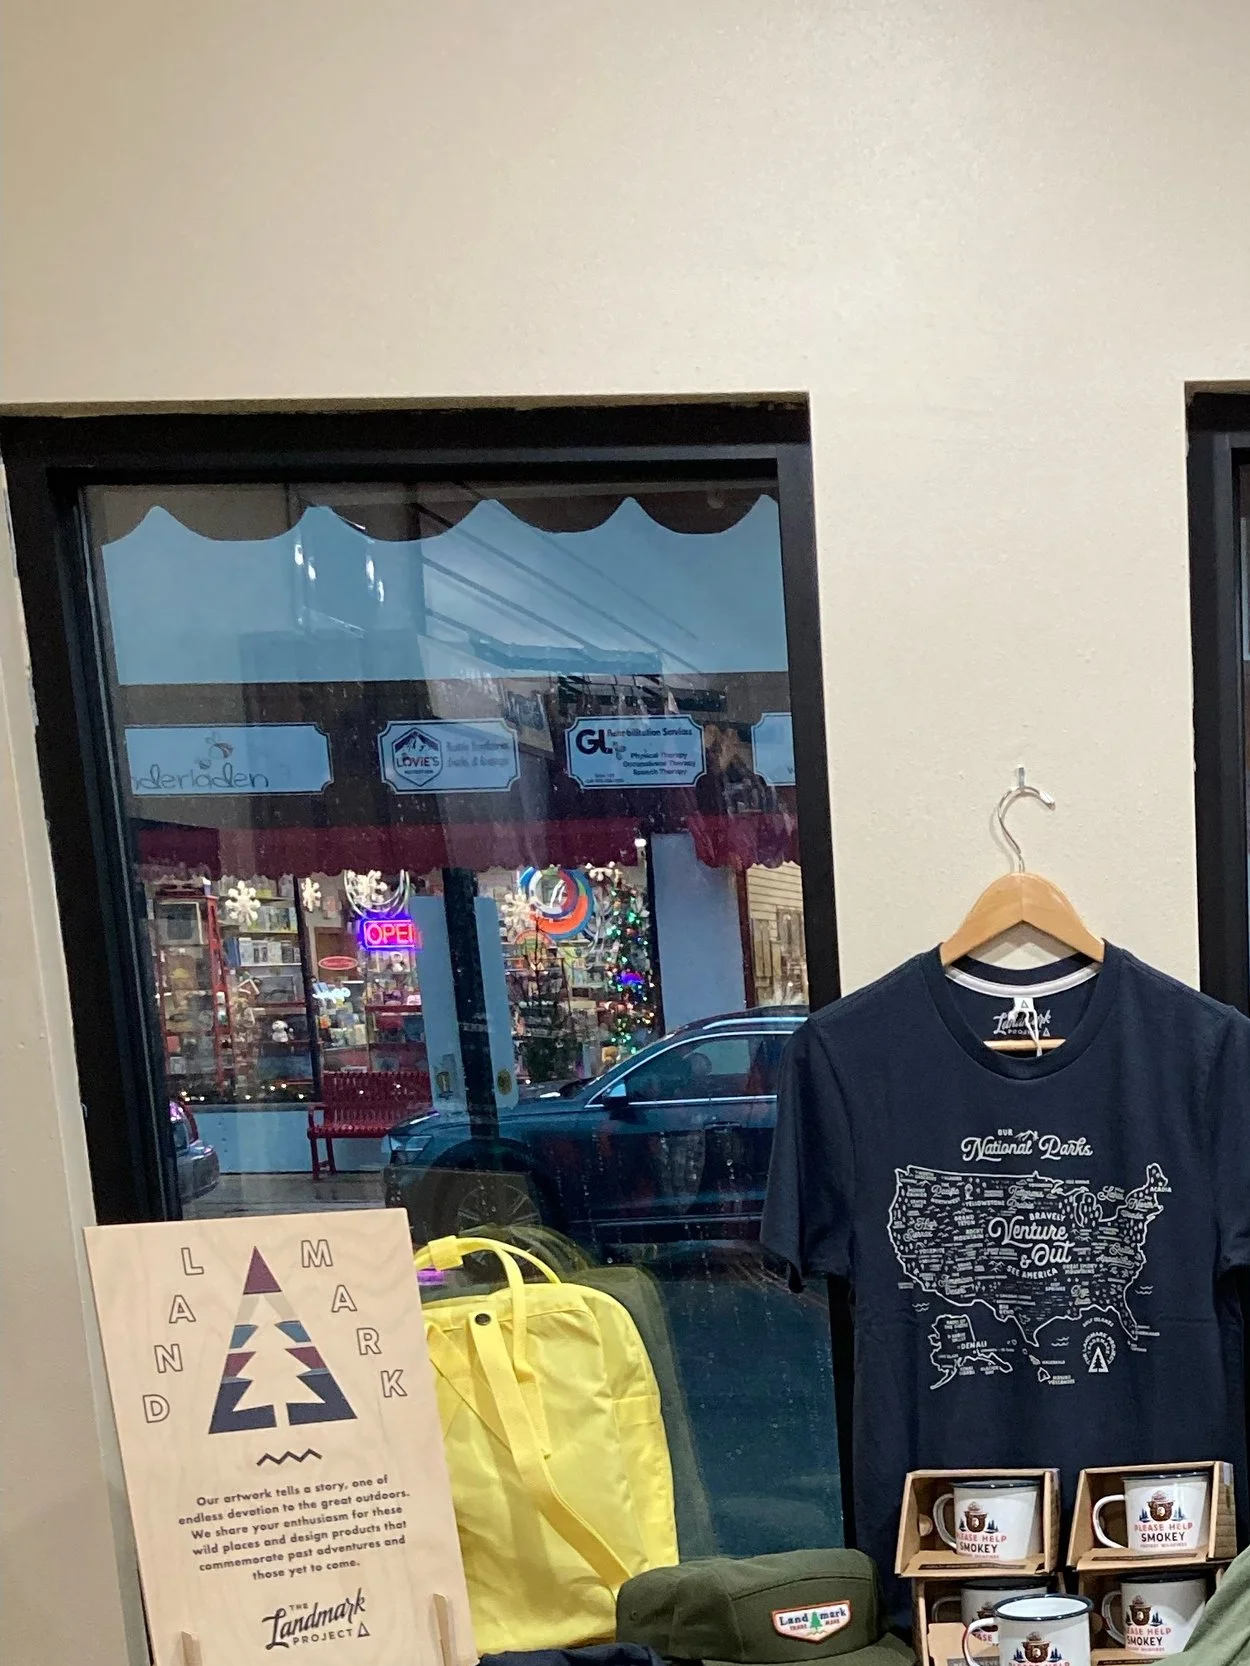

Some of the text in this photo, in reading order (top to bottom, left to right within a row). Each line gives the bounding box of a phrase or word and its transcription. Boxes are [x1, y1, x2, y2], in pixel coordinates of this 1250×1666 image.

[662, 727, 693, 737] Services
[961, 1135, 1093, 1162] National Parks
[1029, 1212, 1066, 1222] BRAVELY
[988, 1217, 1069, 1247] Venture
[1031, 1240, 1076, 1267] Out
[1006, 1265, 1059, 1280] SEE AMERICA
[961, 1340, 987, 1350] DENALI
[197, 1474, 389, 1507] Our artwork tells a story, one of
[178, 1489, 410, 1526] endless devotion to the great outdoors.
[191, 1505, 403, 1540] We share your enthusiasm for these
[1134, 1523, 1193, 1532] PLEASE HELP
[192, 1520, 407, 1556] wild places and design products that
[982, 1534, 1008, 1543] HELP
[1141, 1531, 1185, 1543] SMOKEY
[199, 1535, 406, 1572] commemorate past adventures and
[959, 1542, 998, 1554] SMOKEY
[252, 1559, 361, 1581] those yet to come.
[289, 1603, 308, 1611] THE
[261, 1587, 366, 1651] Landmark
[779, 1608, 846, 1626] Land mark
[292, 1629, 353, 1645] PROJECT
[1147, 1627, 1172, 1636] HELP
[1127, 1636, 1163, 1648] SMOKEY
